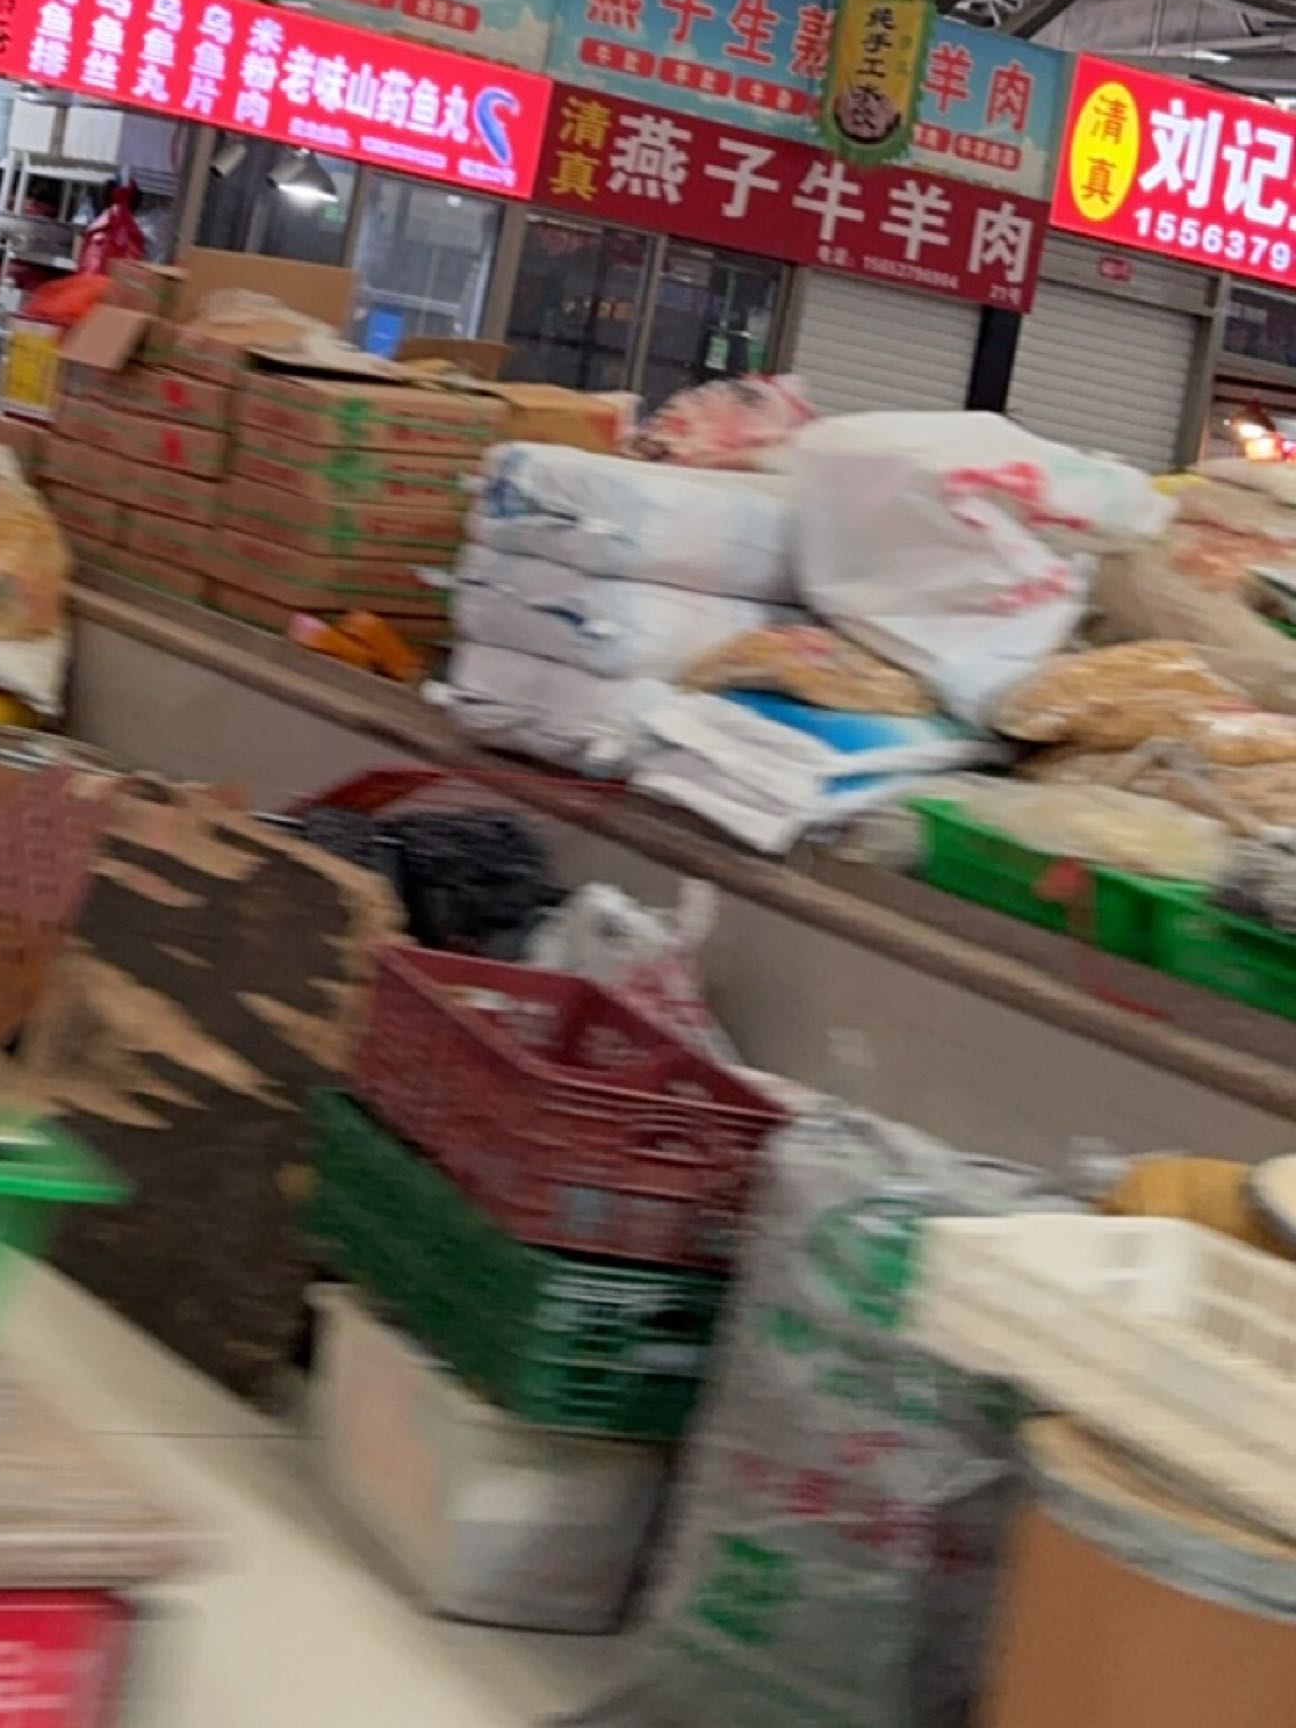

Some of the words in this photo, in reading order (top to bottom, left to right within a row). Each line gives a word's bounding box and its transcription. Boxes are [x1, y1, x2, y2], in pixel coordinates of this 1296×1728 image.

[182, 4, 234, 116] 乌鱼片
[550, 95, 612, 202] 清真
[607, 108, 1032, 284] 燕子牛羊肉
[1080, 93, 1128, 205] 清真
[1138, 98, 1296, 229] 刘记
[1133, 206, 1292, 272] 1556379
